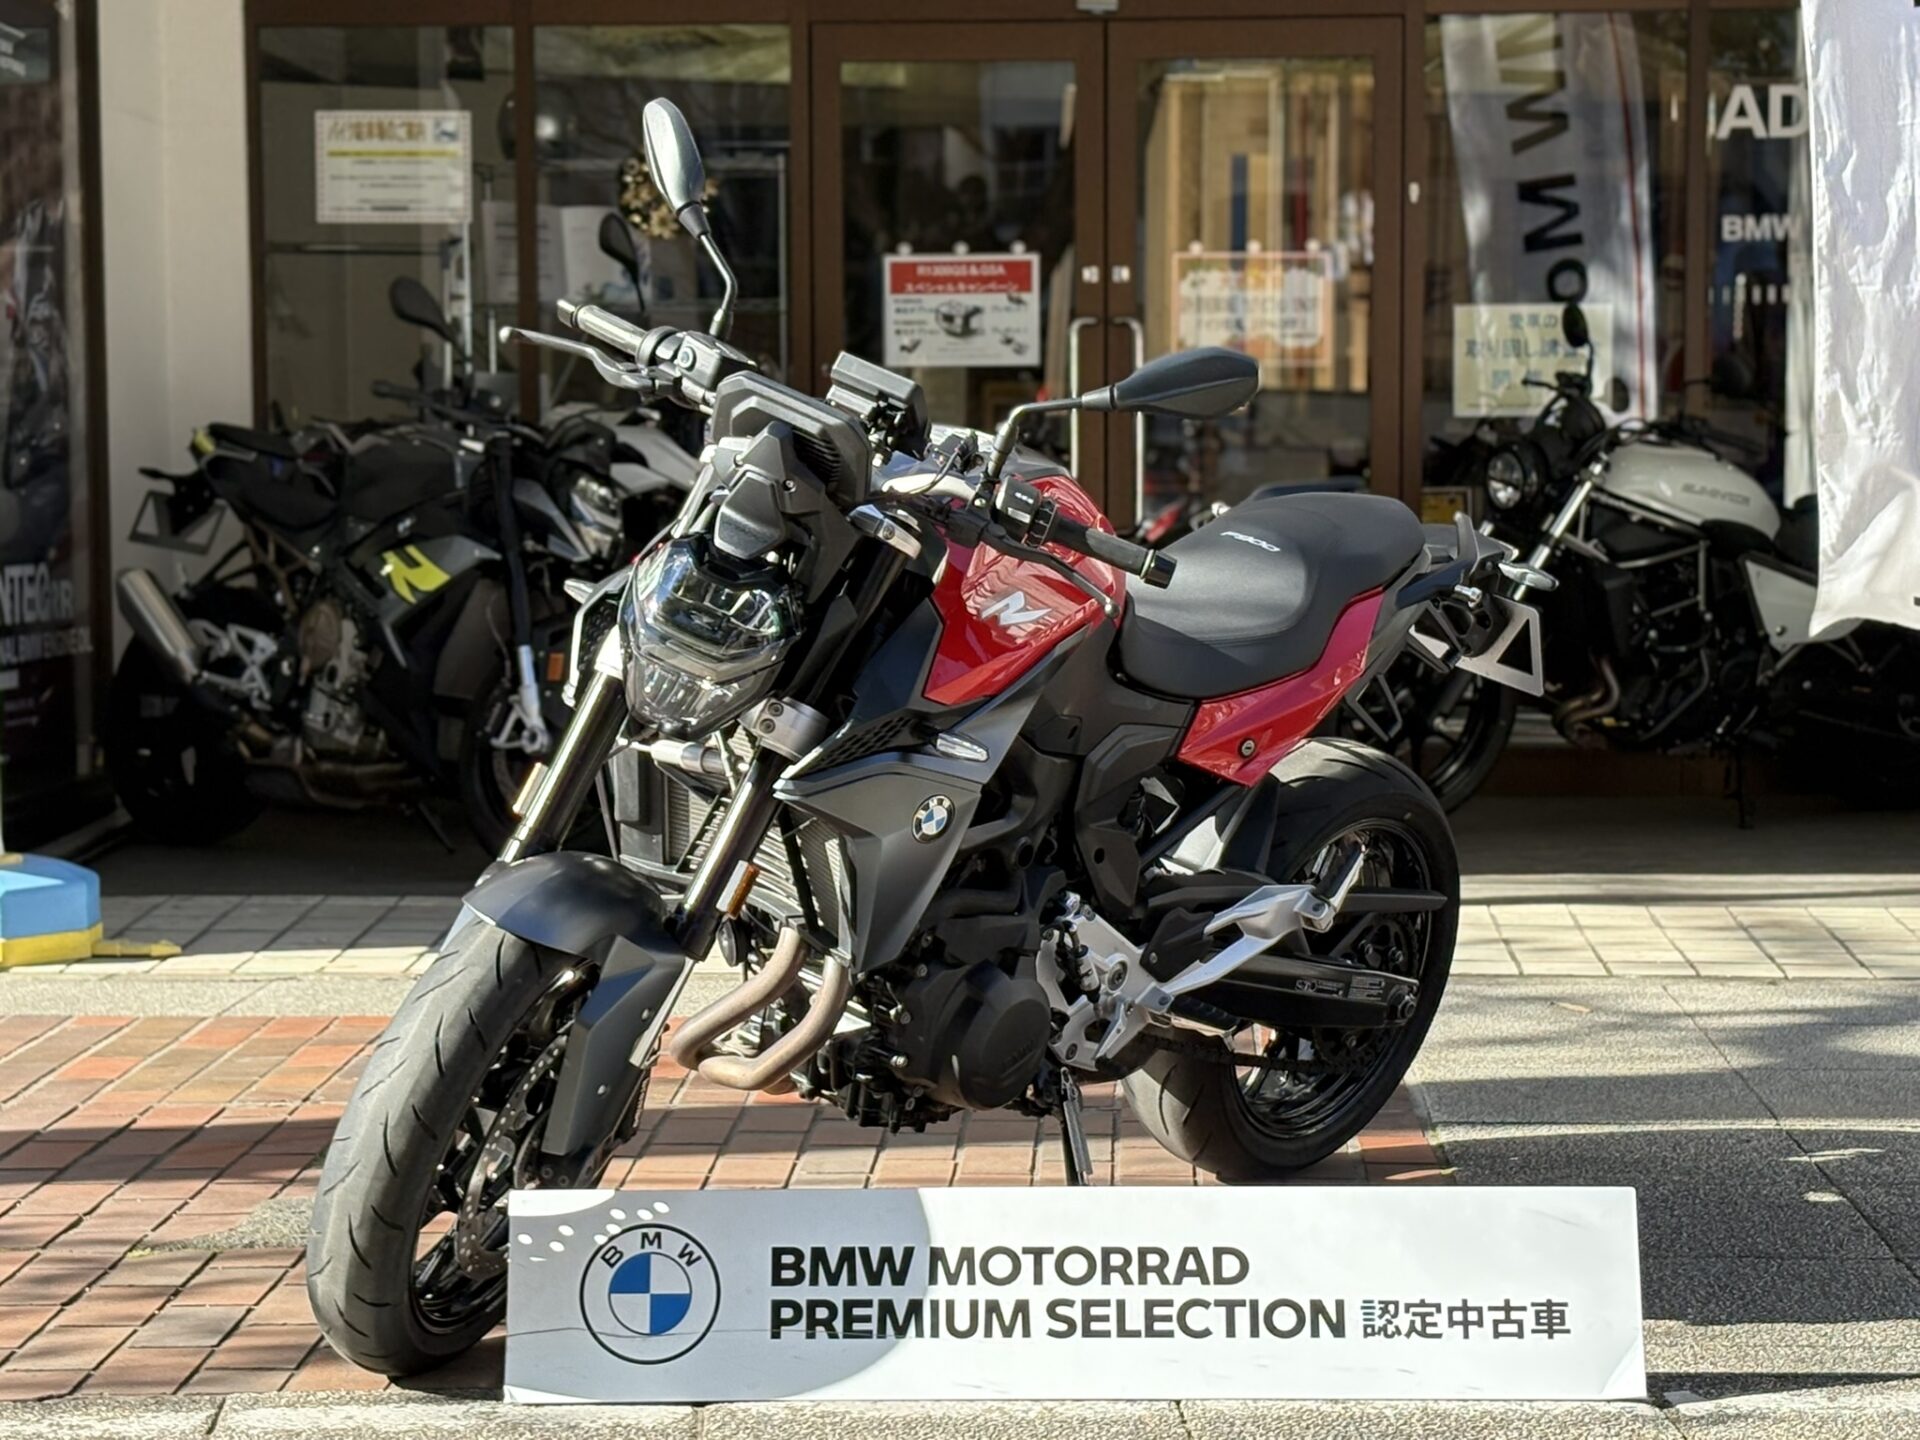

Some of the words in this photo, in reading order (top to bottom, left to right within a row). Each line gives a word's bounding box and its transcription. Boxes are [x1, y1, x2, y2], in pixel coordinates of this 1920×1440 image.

[1721, 214, 1801, 242] BMW
[600, 1231, 702, 1269] BMW
[770, 1246, 915, 1287] BMW
[928, 1246, 1250, 1287] MOTORRAD
[770, 1298, 1031, 1340] PREMIUM
[1045, 1298, 1346, 1340] SELECTION
[1360, 1298, 1572, 1340] 認定中古車
